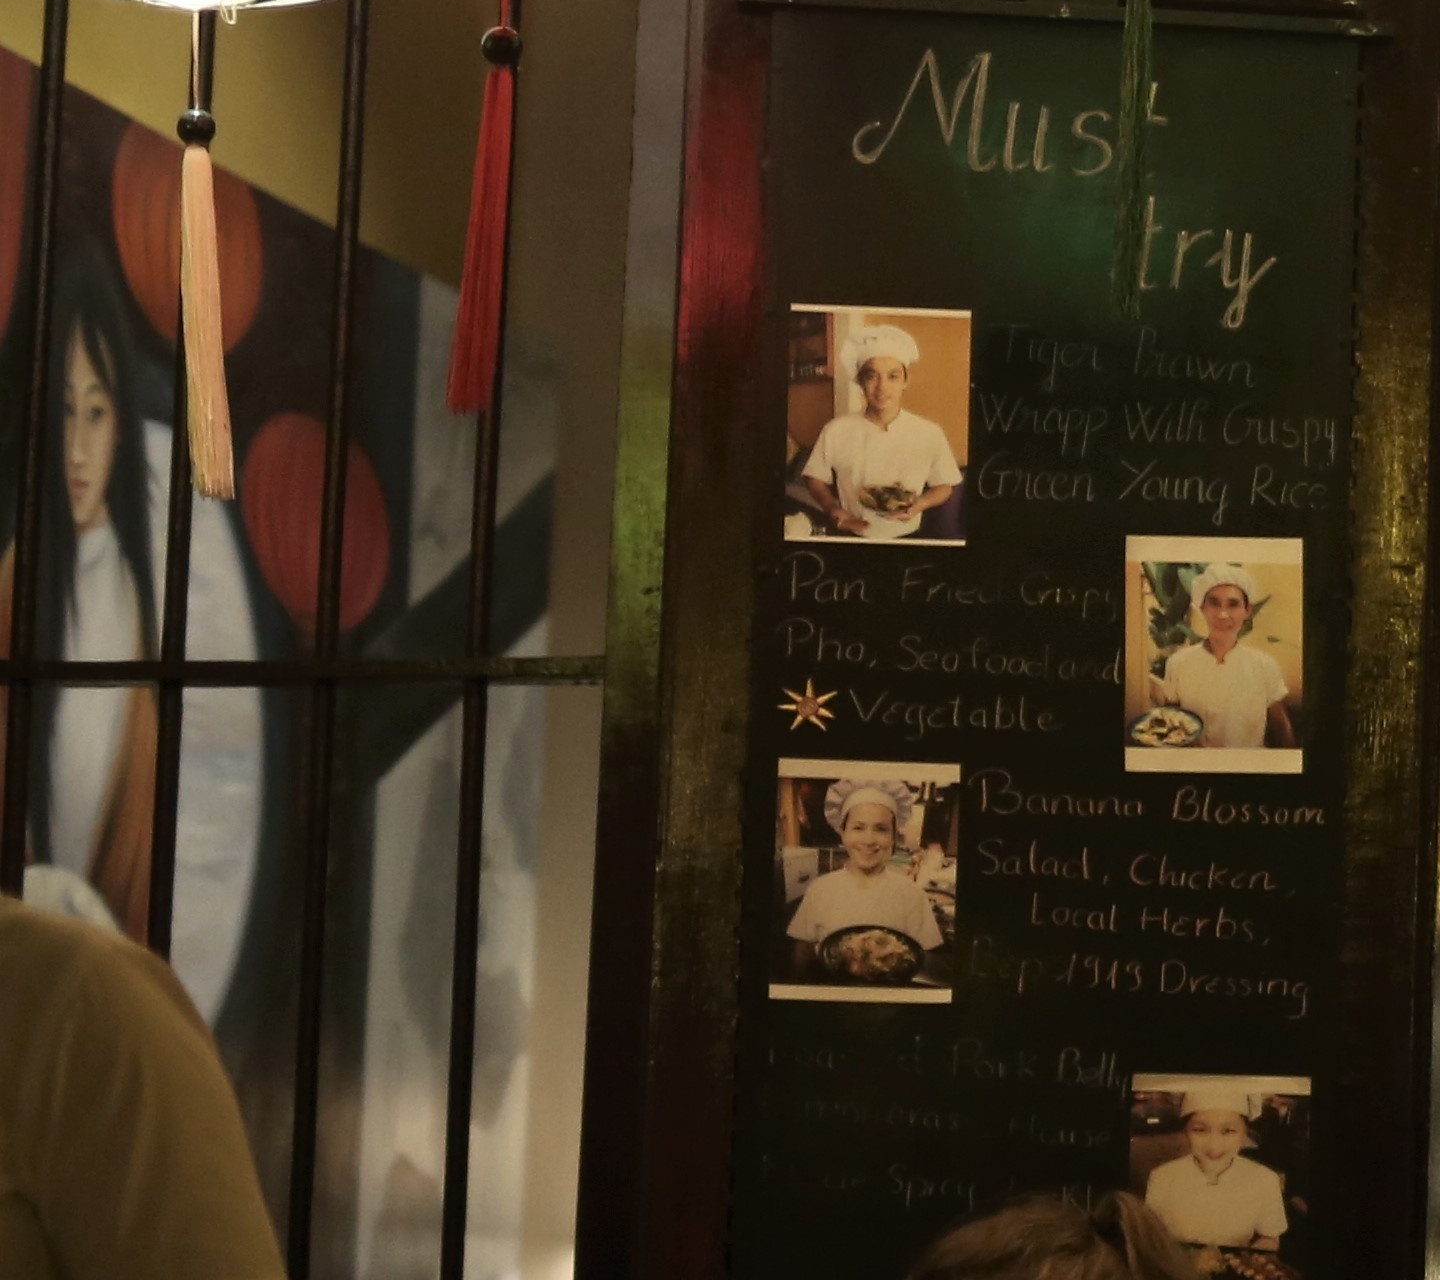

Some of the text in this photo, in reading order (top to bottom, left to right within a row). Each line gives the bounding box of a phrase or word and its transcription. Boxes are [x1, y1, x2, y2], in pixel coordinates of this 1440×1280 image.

[1138, 193, 1278, 329] try
[987, 321, 1258, 394] Tiger Prawn
[978, 391, 1338, 467] Wrapp With Crispy
[977, 449, 1329, 527] Green Young Rice
[780, 548, 872, 607] Pan
[1018, 569, 1119, 624] Crispy
[847, 687, 1065, 742] Vegetable
[967, 766, 1328, 828] Banana Blossom
[975, 837, 1111, 888] Salad,
[1029, 890, 1272, 947] Local Herbs,
[1055, 952, 1143, 992] 1919
[1159, 958, 1311, 1021] Dressing
